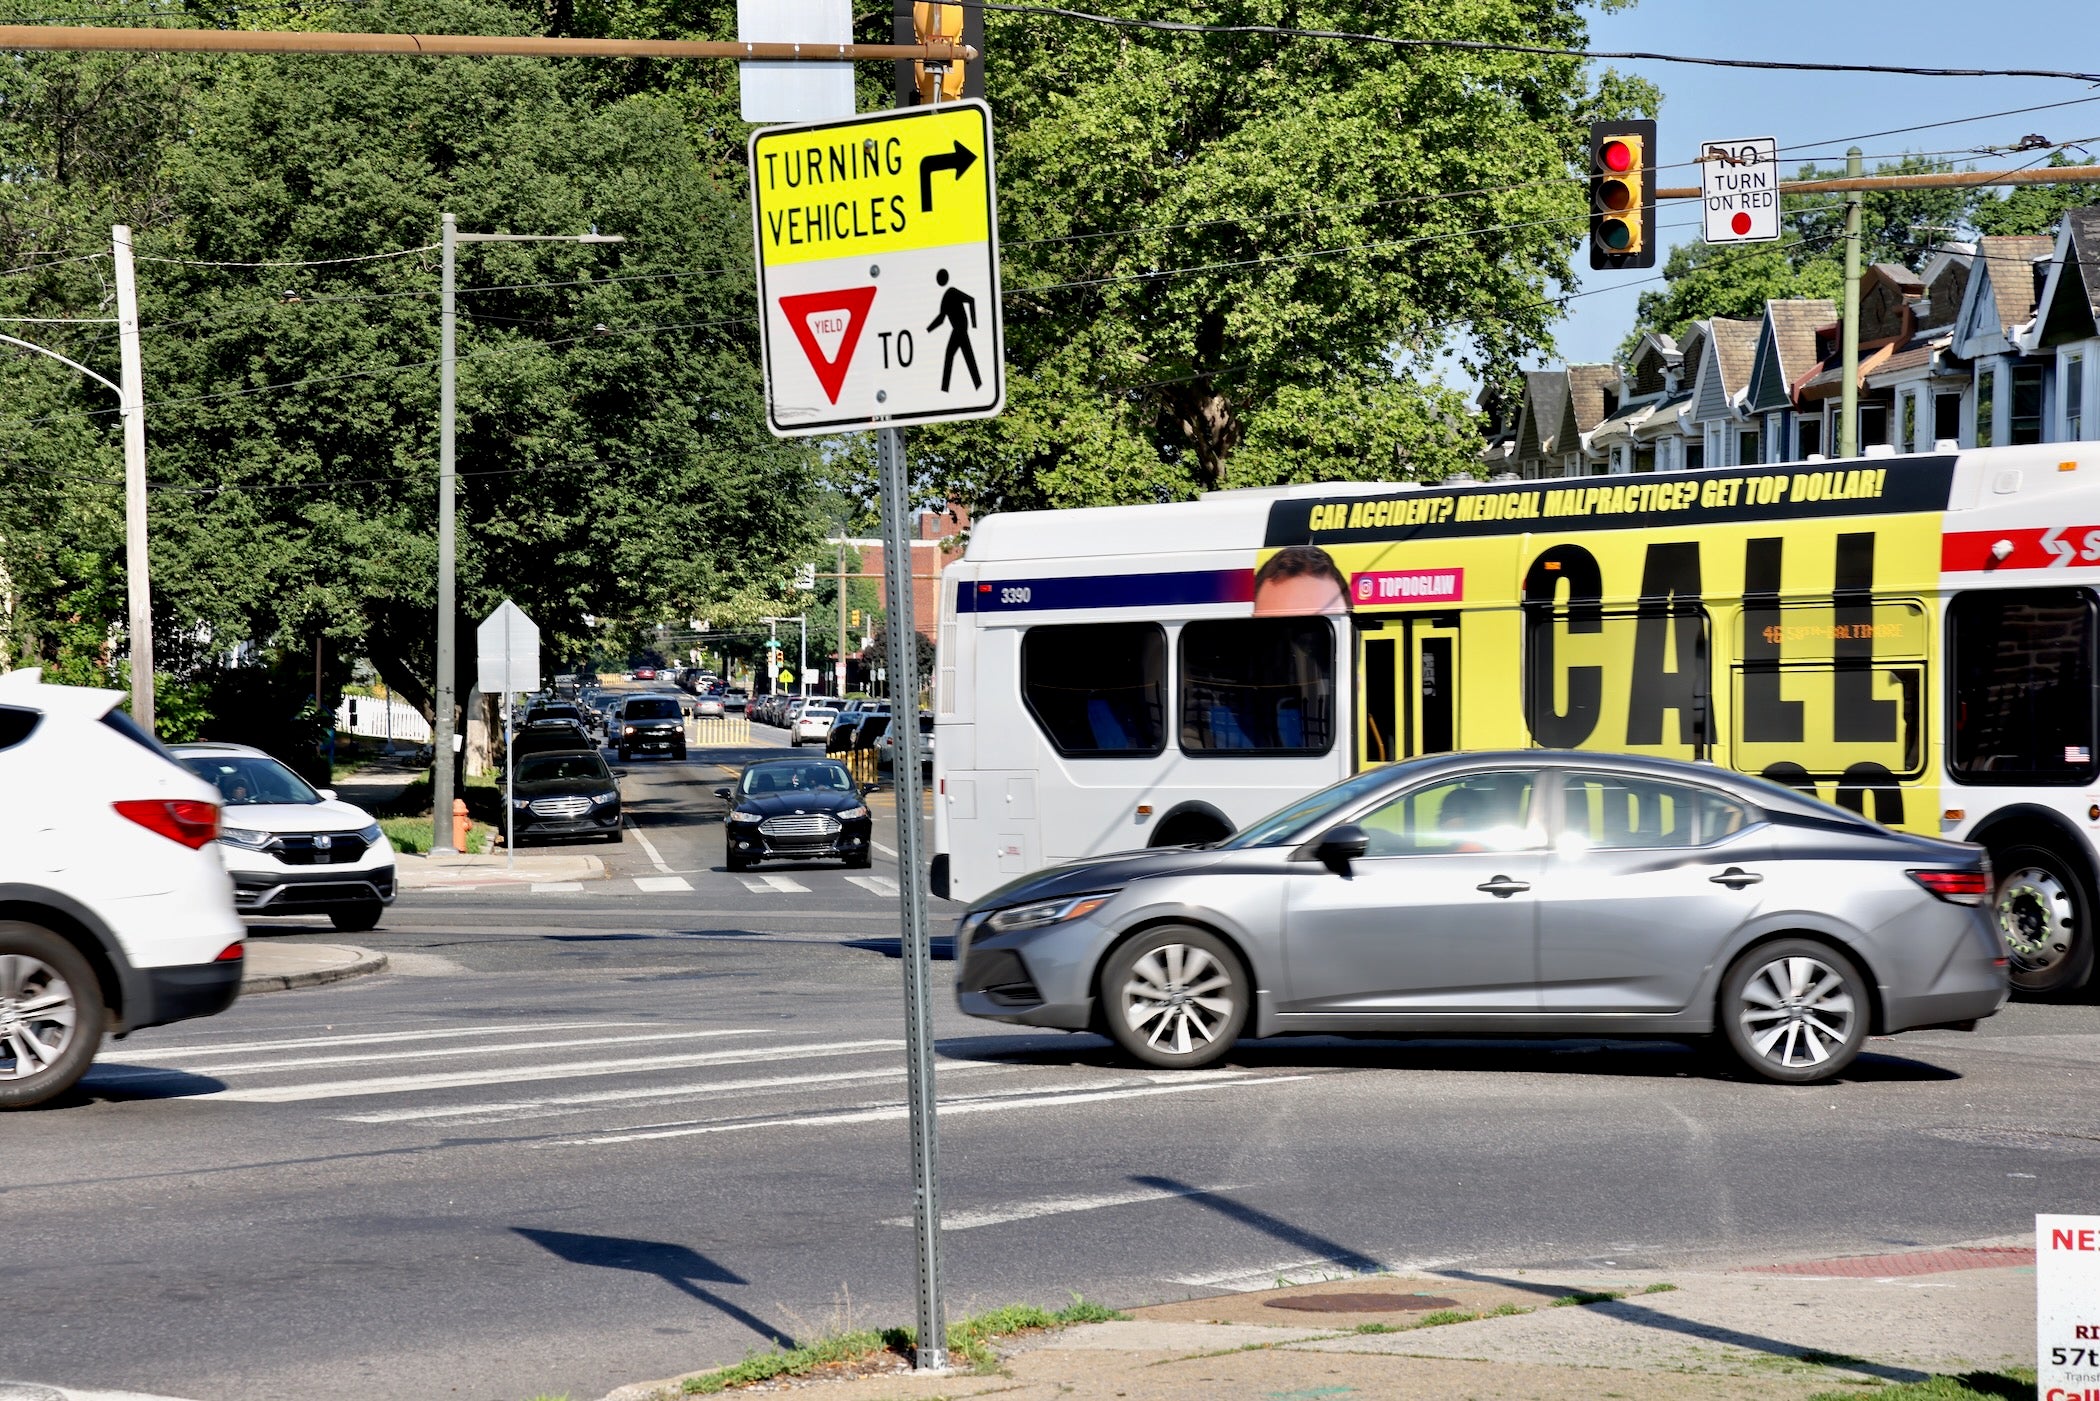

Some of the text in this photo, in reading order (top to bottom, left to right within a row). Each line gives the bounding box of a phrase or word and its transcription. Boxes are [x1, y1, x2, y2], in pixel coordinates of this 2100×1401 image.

[764, 137, 902, 190] TURNING
[1716, 146, 1757, 168] NO
[1715, 172, 1766, 190] TURN
[1709, 192, 1773, 211] ON RED
[768, 194, 906, 247] VEHICLES
[814, 318, 843, 334] YIELD
[878, 329, 914, 370] TO
[1309, 468, 1887, 531] CAR ACCIDENT? MEDICAL MALPRACTICE? GET TOP DOLLAR!
[1000, 587, 1032, 604] 3390
[1378, 574, 1456, 598] TOPDOGLAW
[1523, 532, 1897, 749] CALL
[2052, 1229, 2100, 1251] NE
[2051, 1347, 2099, 1367] 57t
